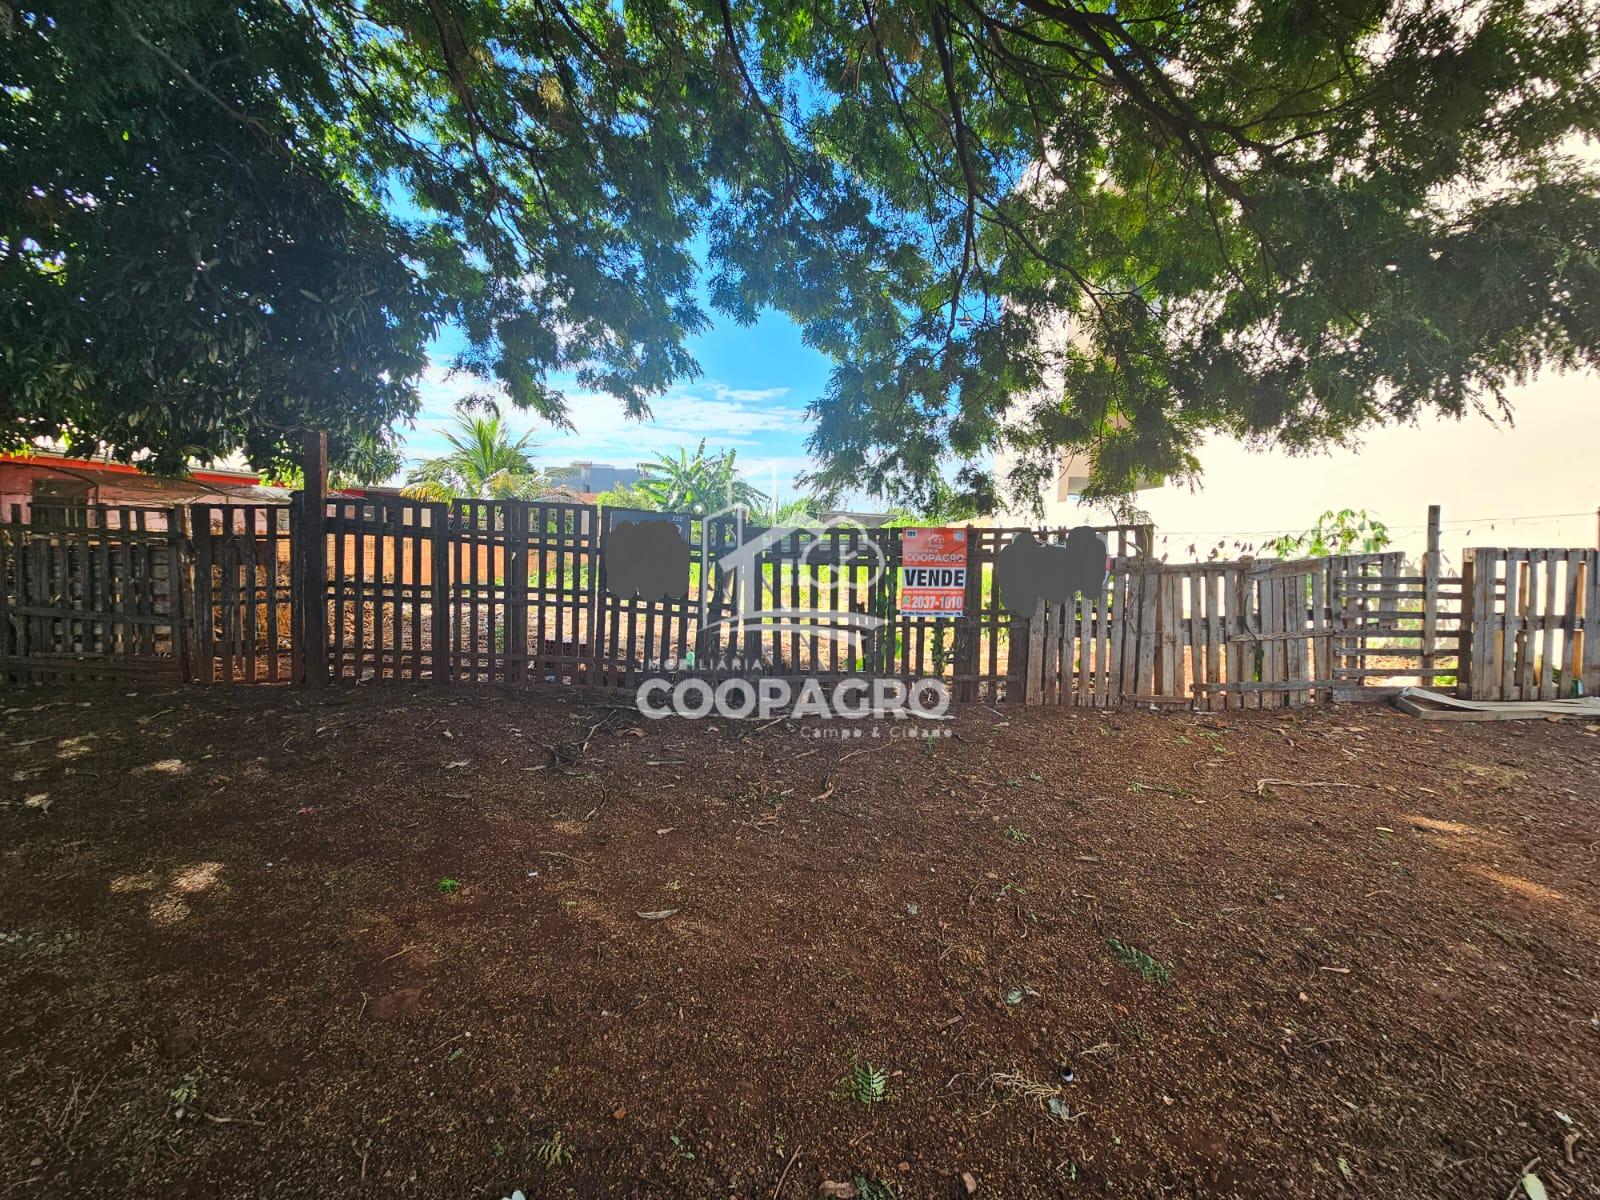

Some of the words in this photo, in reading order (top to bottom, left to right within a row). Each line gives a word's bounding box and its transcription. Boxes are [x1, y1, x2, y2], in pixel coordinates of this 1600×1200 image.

[905, 553, 965, 562] COOPAGRO
[904, 569, 964, 587] VENDE
[912, 595, 963, 609] 2037-1010
